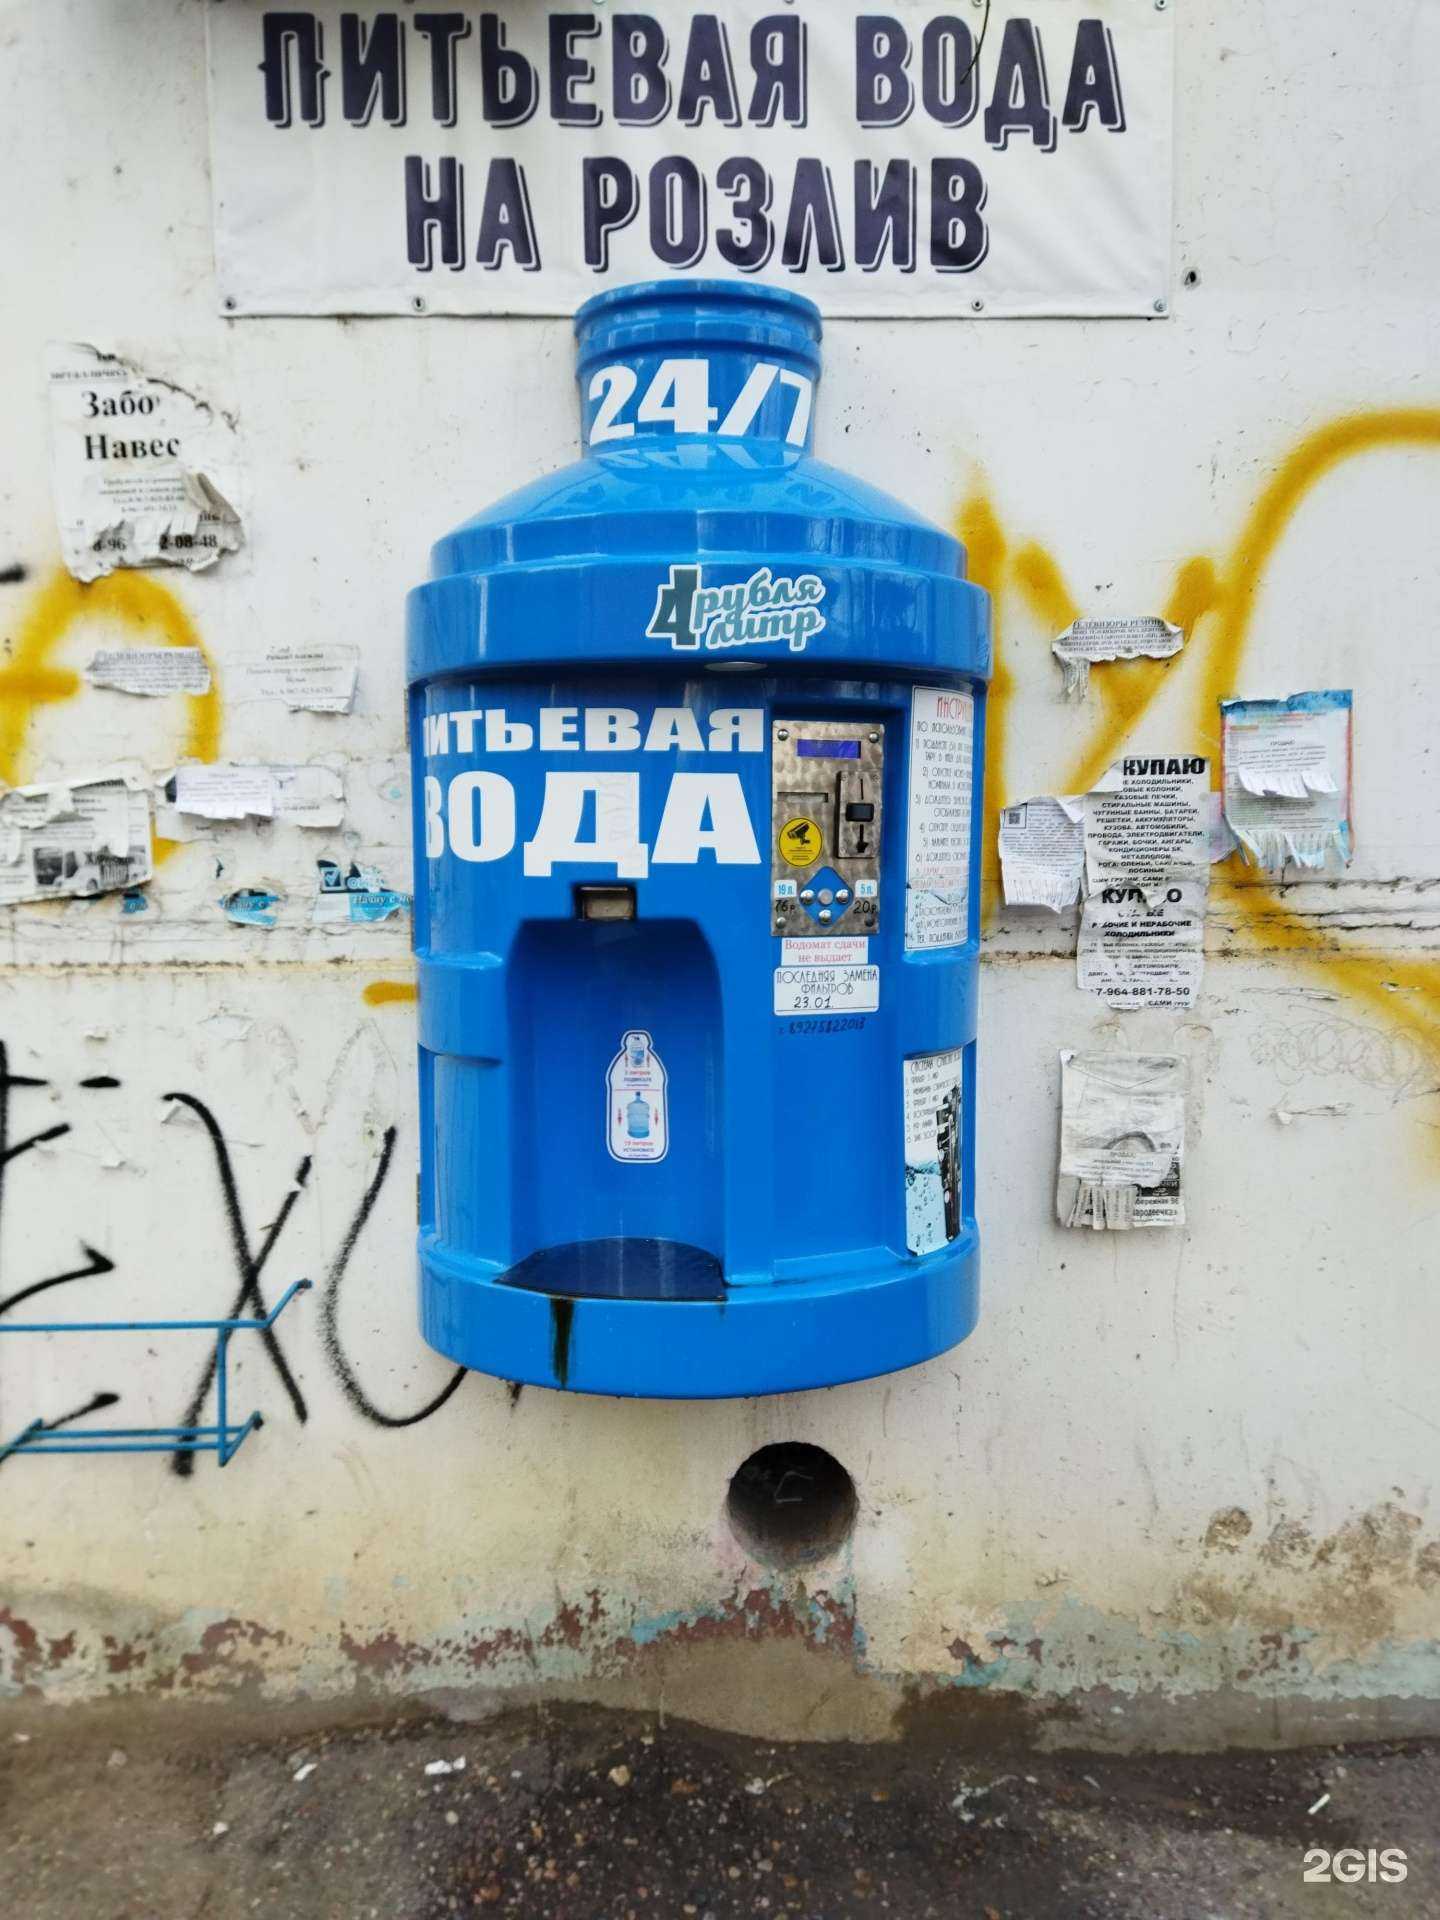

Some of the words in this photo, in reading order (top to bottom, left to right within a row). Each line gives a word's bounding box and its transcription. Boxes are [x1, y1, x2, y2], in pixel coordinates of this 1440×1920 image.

[259, 13, 808, 128] ПИТЬЕВАЯ
[856, 15, 1126, 153] ВОДА
[405, 155, 541, 271] НА
[583, 155, 989, 272] РОЗЛИВ
[81, 390, 160, 418] Забо
[588, 359, 813, 448] 24/7
[85, 434, 180, 461] Навес
[647, 564, 700, 649] 4
[691, 567, 825, 631] рубля
[705, 607, 825, 650] литр
[1123, 758, 1206, 776] КУПАЮ
[424, 771, 762, 878] ВОДА
[785, 940, 832, 951] Водомат
[834, 939, 866, 951] сдачи
[1104, 930, 1175, 938] ХОЛОДИЛЬНИКИ
[798, 955, 812, 963] не
[814, 953, 852, 964] выдает
[776, 970, 836, 985] ПОСЛЕДНЯЯ
[843, 969, 879, 982] ЗАМЕНА
[800, 982, 855, 996] ФИЛЬТРОВ
